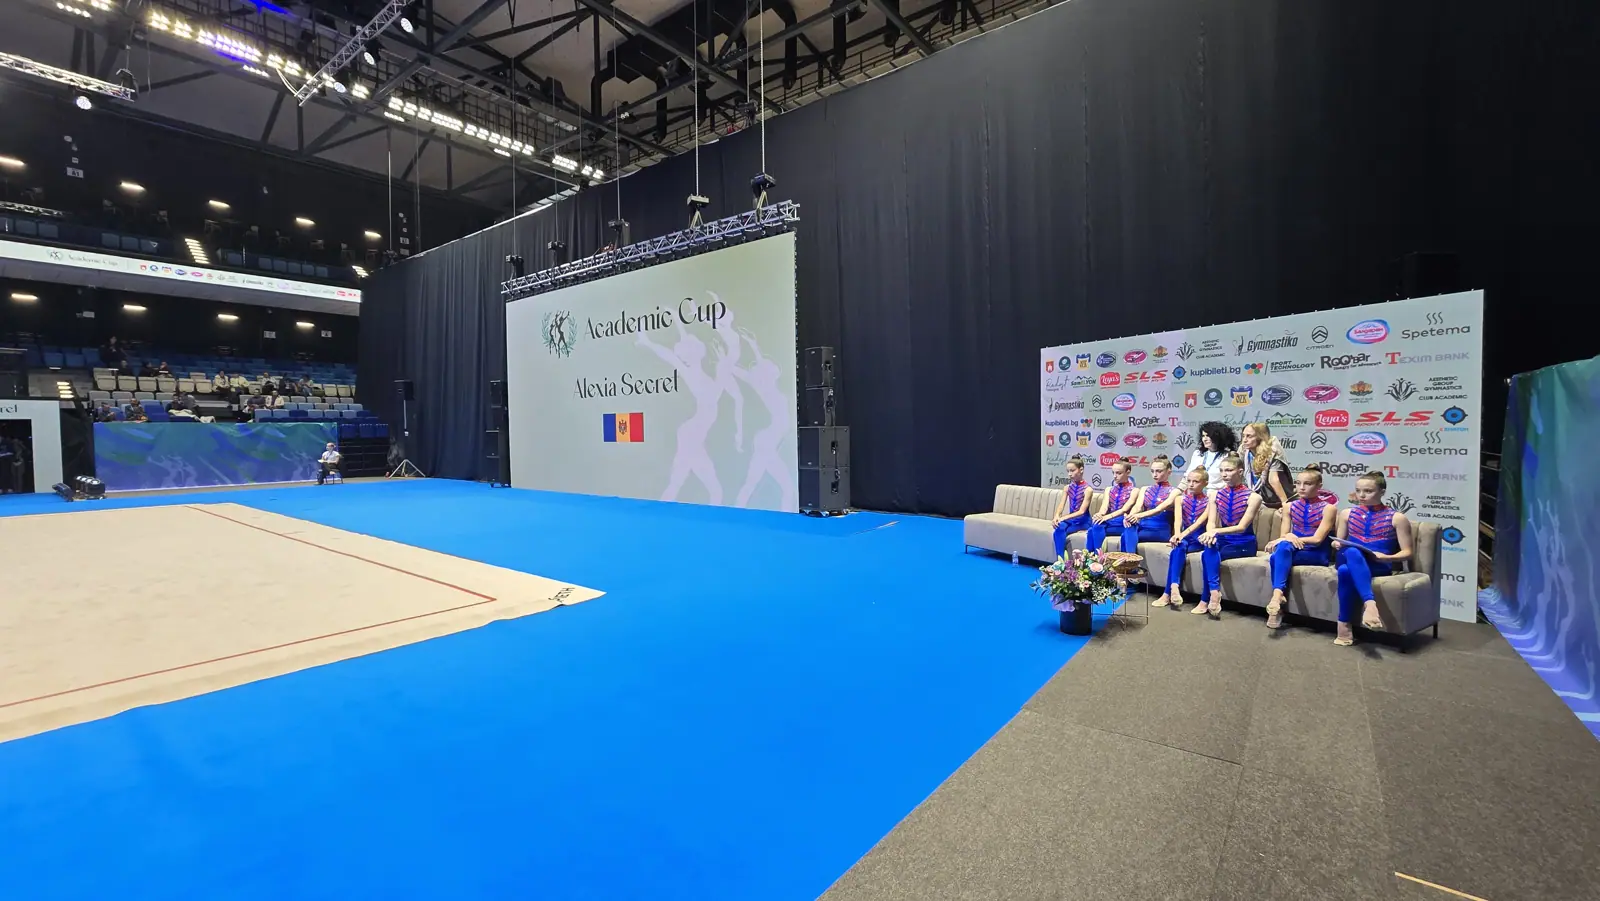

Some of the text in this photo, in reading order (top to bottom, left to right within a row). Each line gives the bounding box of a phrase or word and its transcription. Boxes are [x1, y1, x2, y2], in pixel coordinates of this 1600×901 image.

[584, 297, 726, 339] Academic Cup
[1401, 326, 1471, 340] Spetema
[1434, 352, 1470, 361] BANK
[1124, 370, 1168, 380] SLS
[573, 369, 679, 399] Alexia Secret
[1142, 402, 1179, 410] Spetema
[1356, 411, 1435, 423] SLS
[1400, 445, 1468, 456] Spetema
[1432, 472, 1468, 481] BANK
